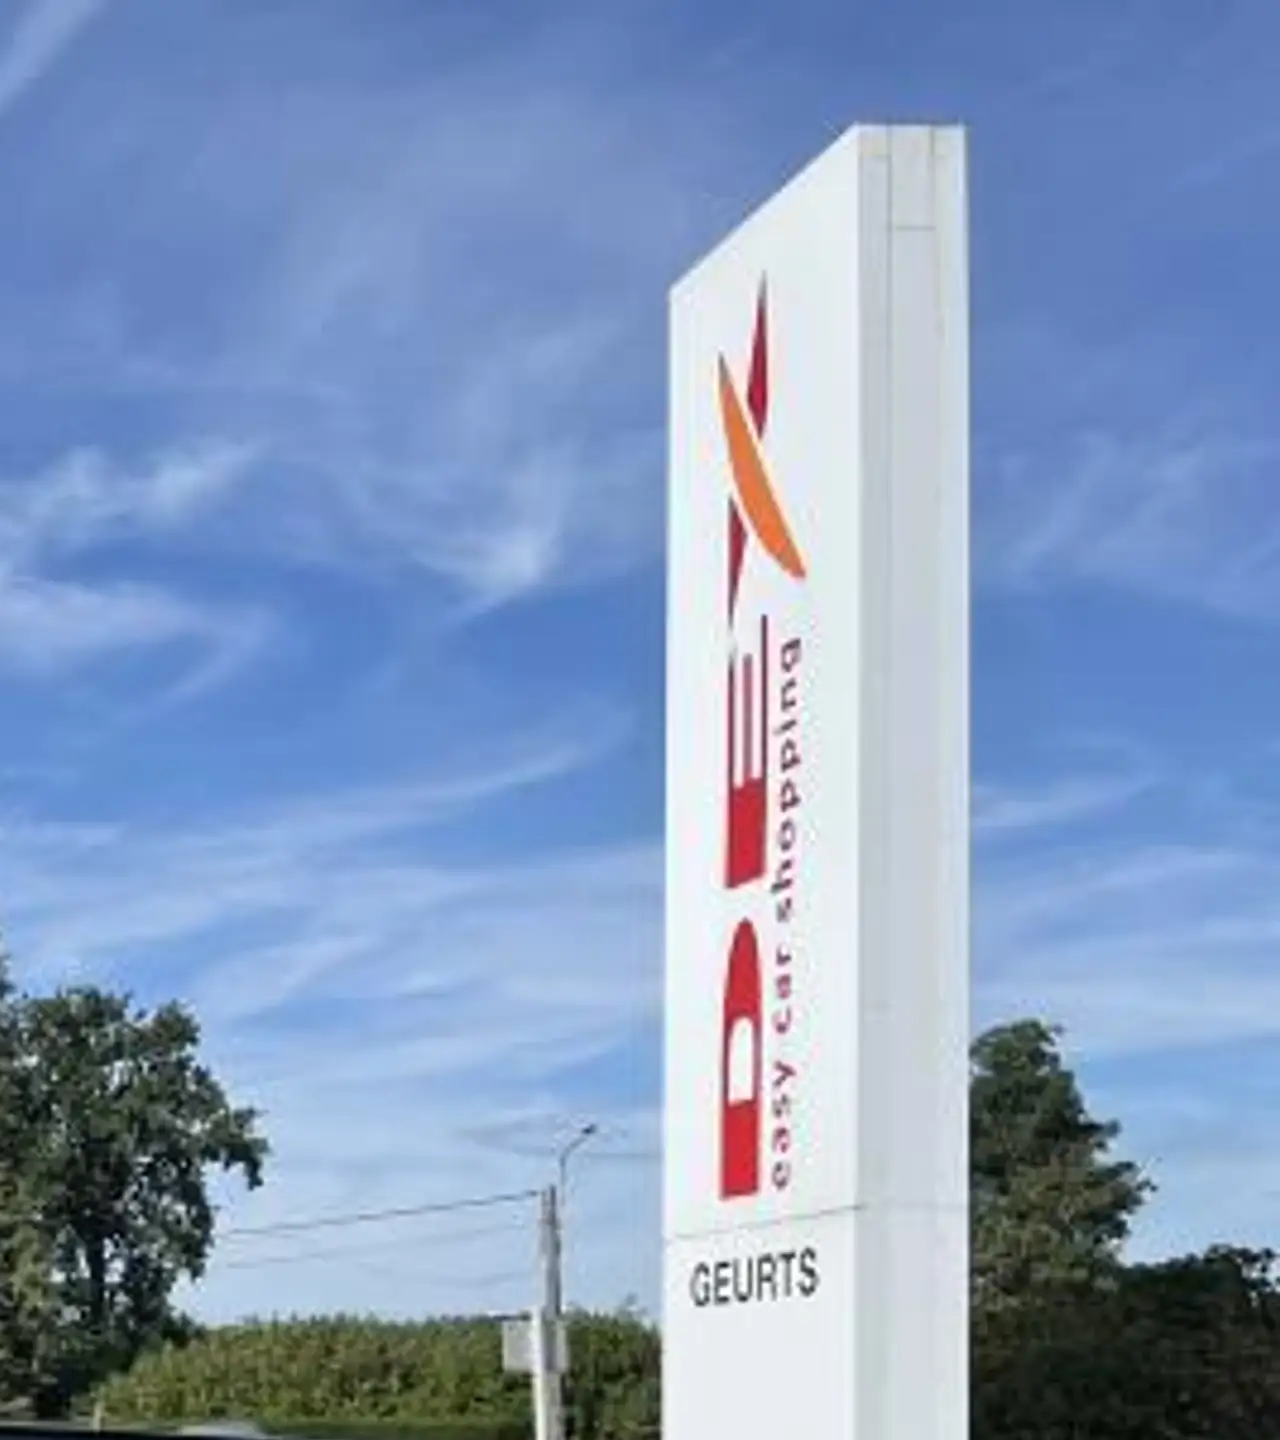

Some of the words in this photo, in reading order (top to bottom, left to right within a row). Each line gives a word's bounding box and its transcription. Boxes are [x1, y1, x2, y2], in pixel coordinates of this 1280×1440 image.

[771, 637, 802, 923] shopping
[771, 946, 793, 1034] car
[771, 1060, 797, 1191] easy
[689, 1246, 821, 1308] GEURTS
